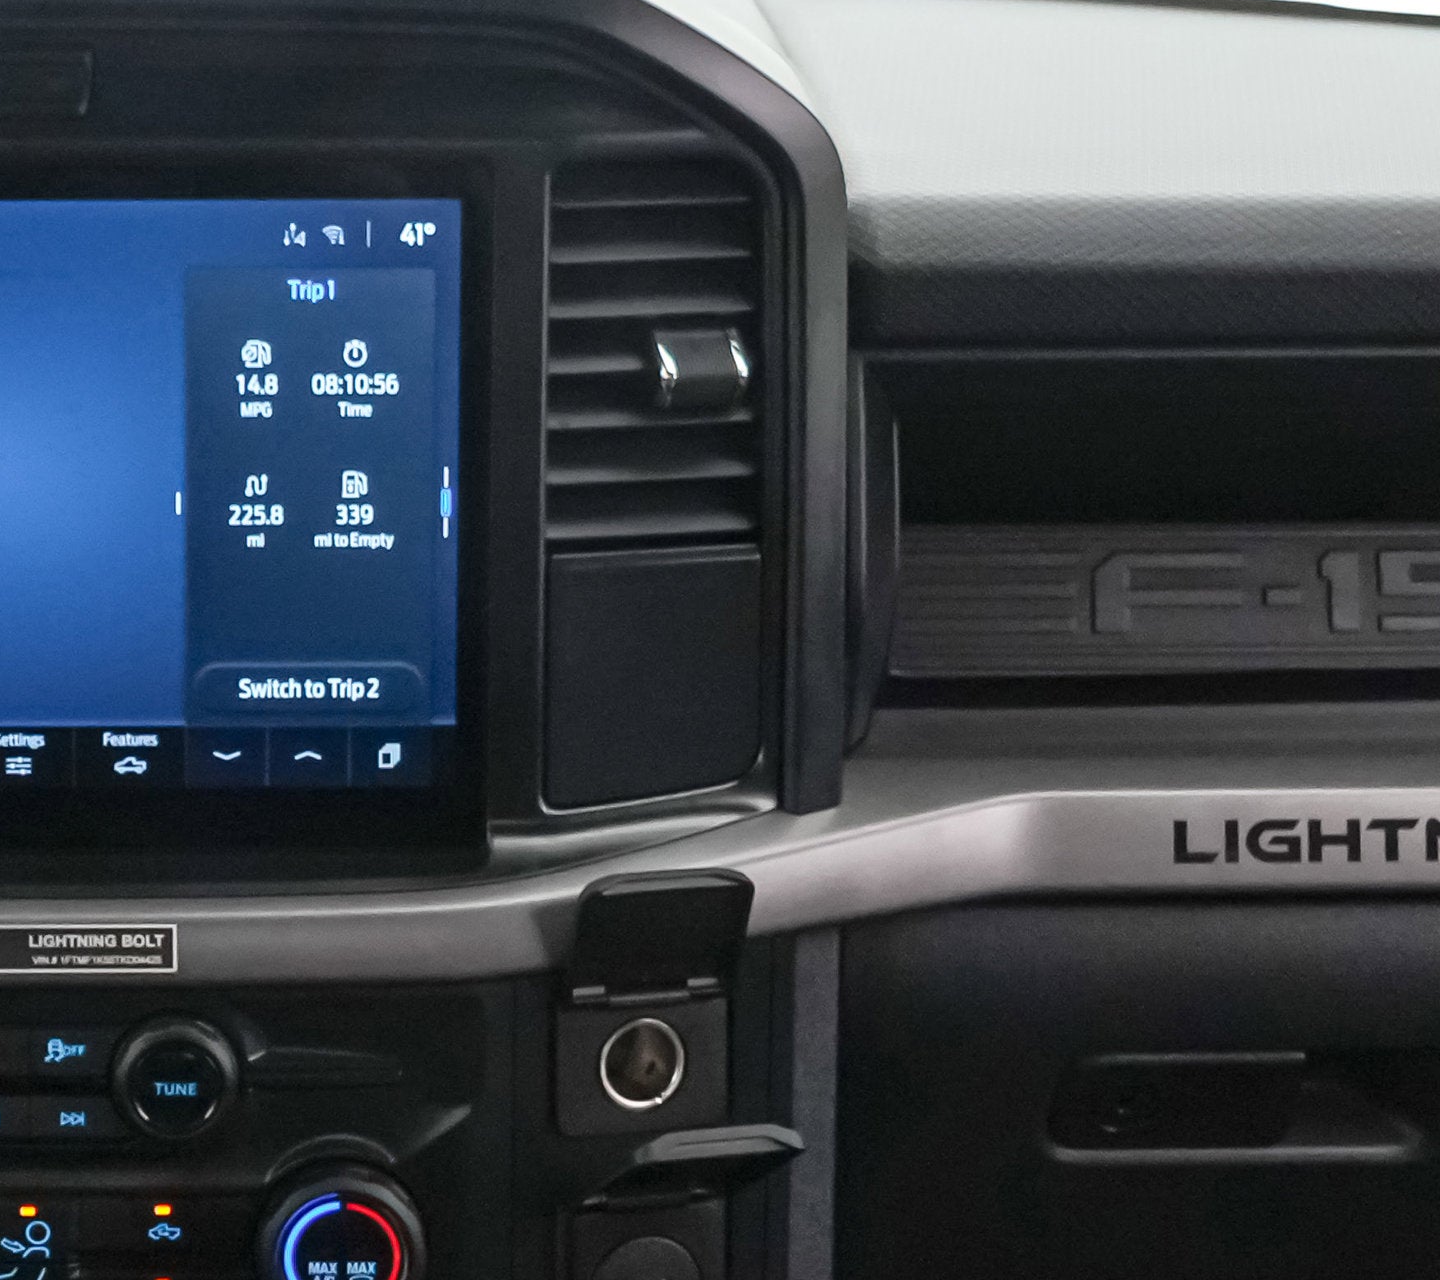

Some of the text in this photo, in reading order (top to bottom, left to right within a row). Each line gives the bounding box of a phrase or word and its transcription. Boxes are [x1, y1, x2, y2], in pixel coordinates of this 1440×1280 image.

[287, 279, 337, 303] Trip 1
[236, 373, 279, 396] 14.8
[311, 373, 401, 396] 08:10:56
[240, 401, 273, 418] MPG
[337, 401, 373, 418] Time
[228, 504, 285, 526] 225.8
[336, 503, 375, 526] 339
[246, 532, 266, 548] mi
[314, 531, 396, 550] mi to Empty
[238, 677, 380, 702] Switch to Trip 2
[102, 731, 159, 748] Features
[28, 933, 166, 950] LIGHTNING BOLT
[154, 1081, 198, 1097] TUNE
[308, 1261, 338, 1275] MAX
[346, 1261, 377, 1275] MAX
